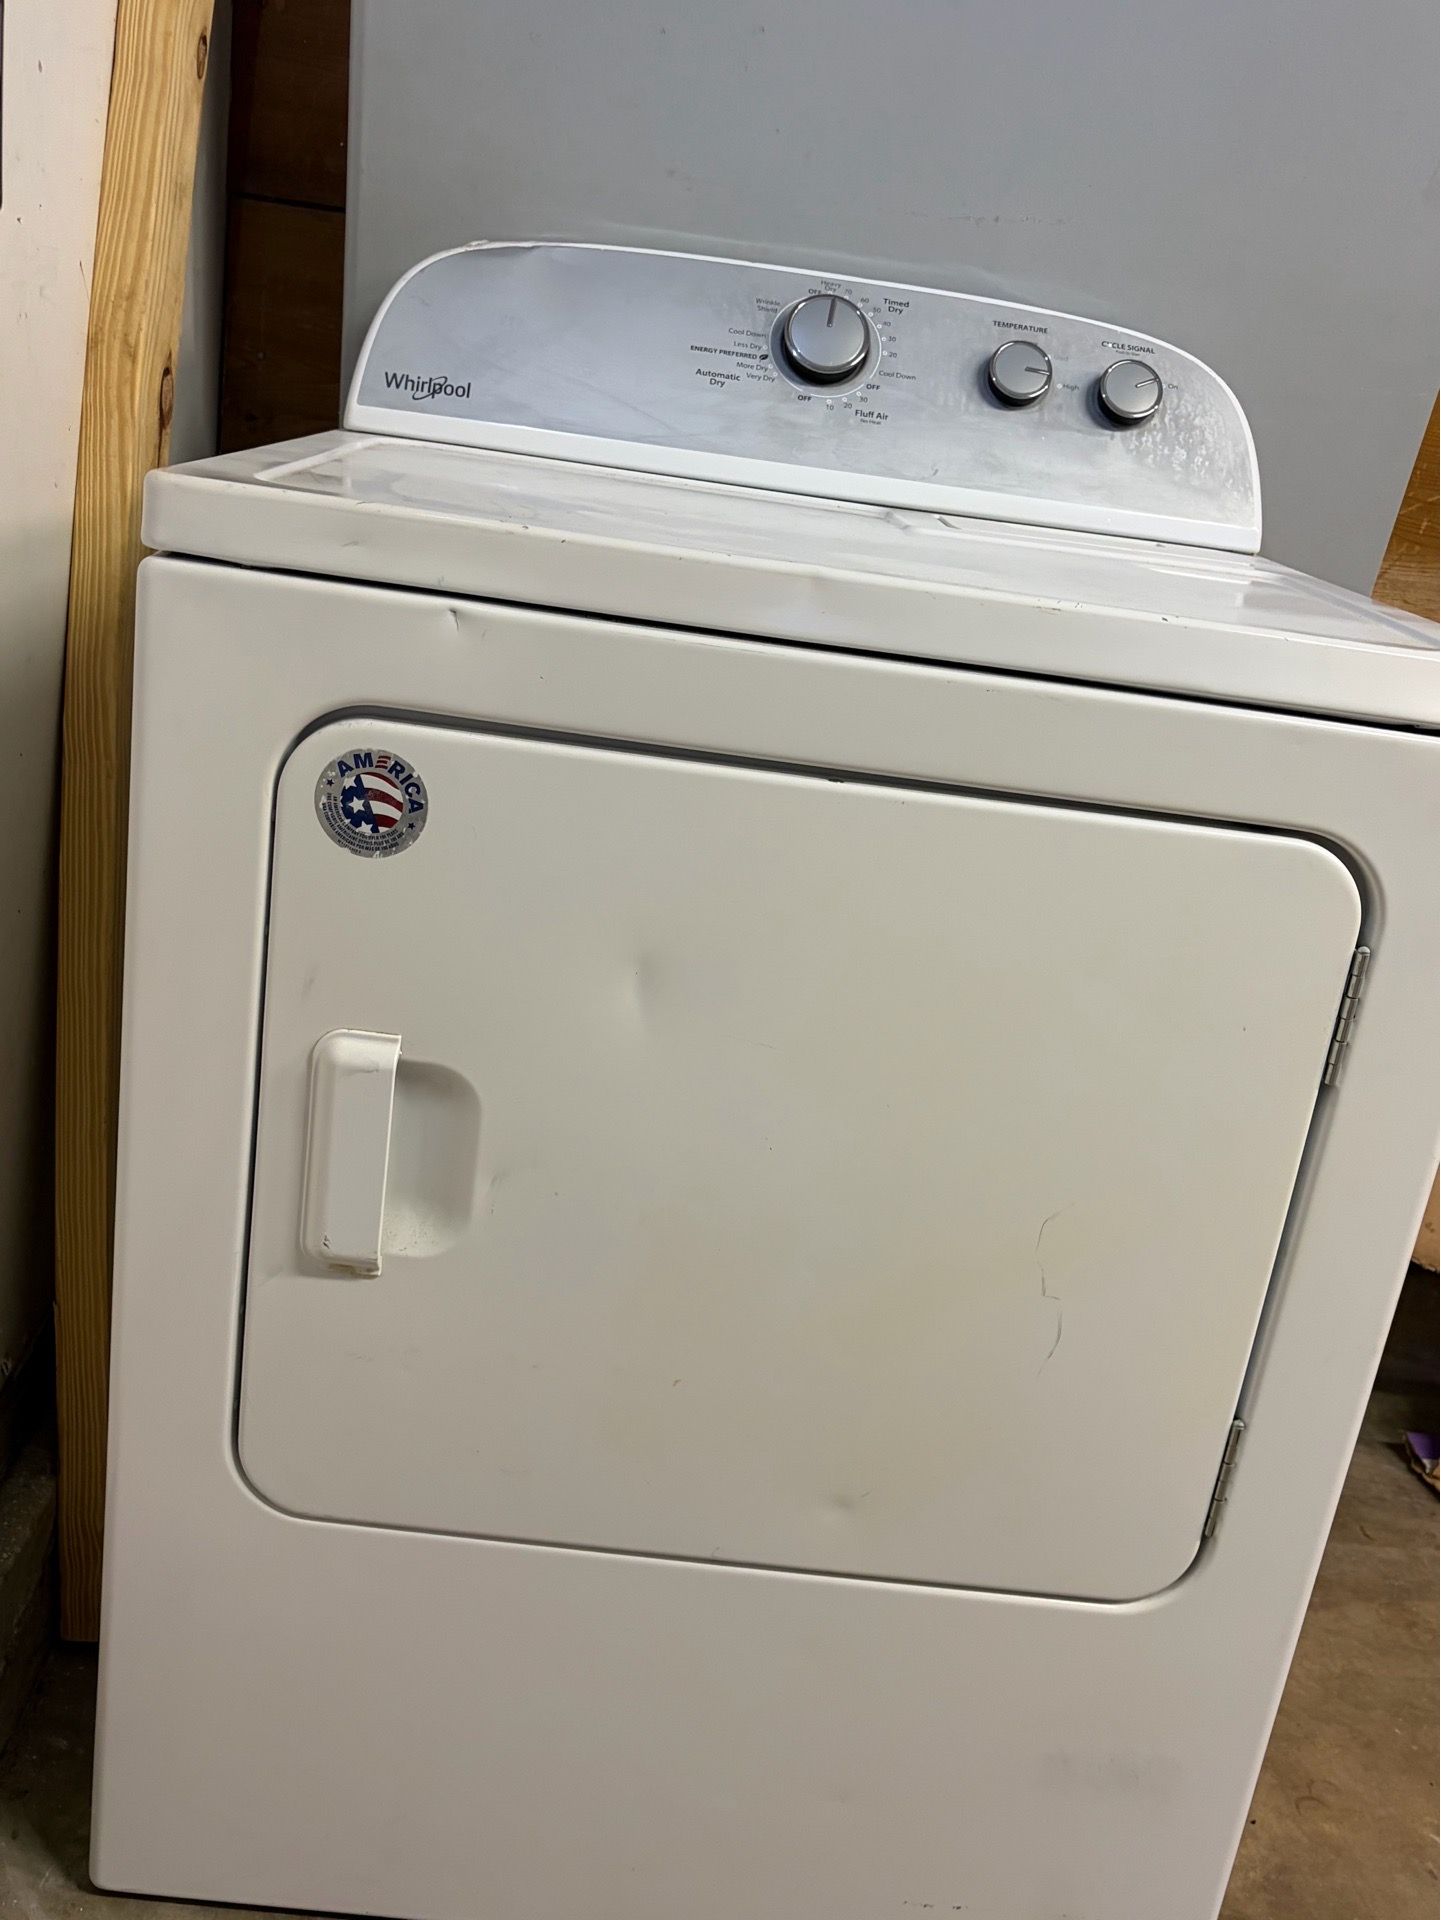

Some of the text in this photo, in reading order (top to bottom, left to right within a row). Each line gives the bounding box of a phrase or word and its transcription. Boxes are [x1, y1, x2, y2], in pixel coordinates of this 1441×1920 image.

[883, 298, 910, 308] Timed
[888, 305, 904, 315] Dry
[992, 320, 1049, 335] TEMPERATURE
[733, 341, 762, 351] Less Dry
[1127, 344, 1156, 354] SIGNAL
[690, 345, 758, 360] ENERGY PREFERRED
[736, 361, 768, 373] More Dry
[695, 368, 741, 382] Automatic
[746, 372, 776, 383] Very Dry
[878, 370, 917, 381] Cool Down
[384, 371, 471, 400] Whirlpool
[709, 378, 726, 388] Dry
[1063, 383, 1080, 391] High
[1167, 382, 1178, 390] On
[797, 394, 812, 402] OFF
[826, 403, 834, 411] 10
[855, 409, 889, 421] Fluff Air
[337, 752, 424, 814] AMERICA
